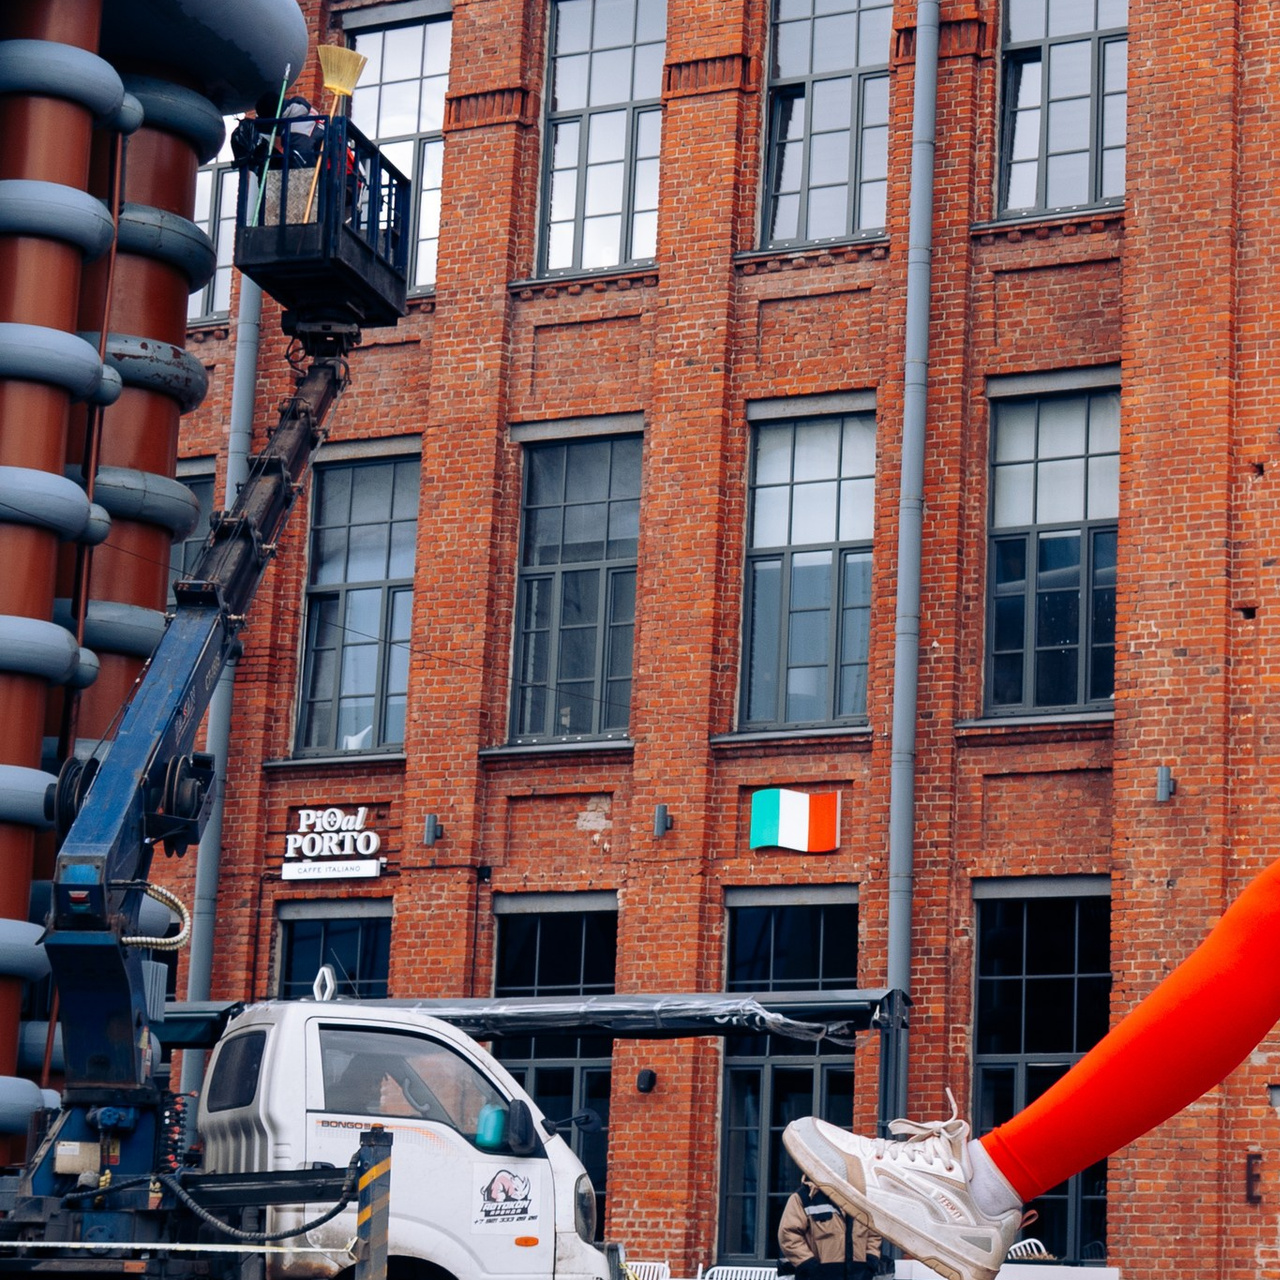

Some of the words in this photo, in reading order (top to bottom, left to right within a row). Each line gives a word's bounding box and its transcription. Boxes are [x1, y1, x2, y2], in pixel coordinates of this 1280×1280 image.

[285, 831, 381, 857] PORTO
[325, 865, 361, 873] ITALIANO
[321, 1120, 363, 1130] BONGO
